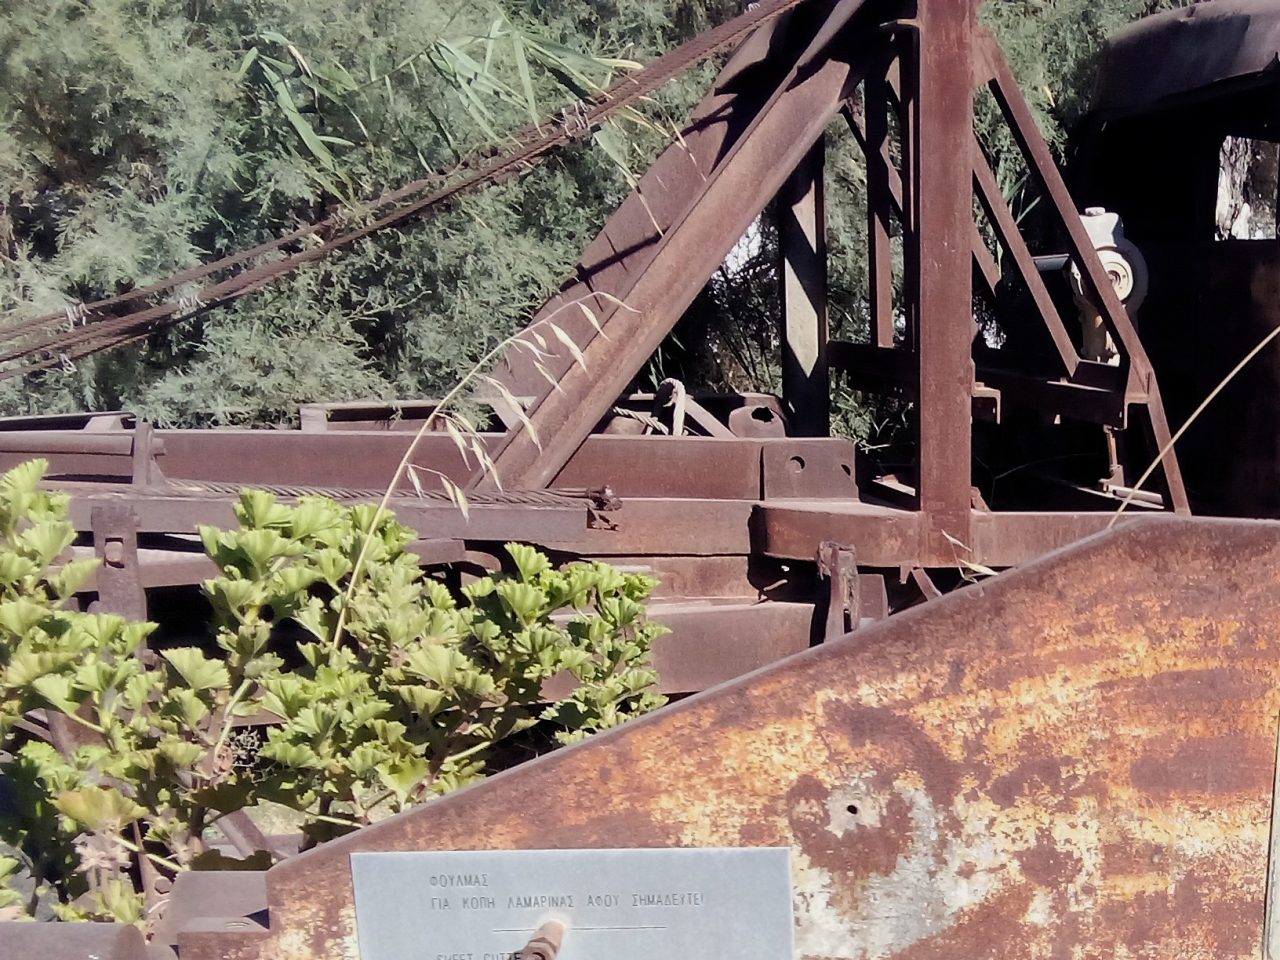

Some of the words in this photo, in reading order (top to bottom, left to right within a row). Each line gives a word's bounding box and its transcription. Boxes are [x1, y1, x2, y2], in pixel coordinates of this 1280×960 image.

[431, 896, 450, 910] ΓΙΑ
[463, 895, 495, 909] ΚΟΠΗ
[507, 894, 575, 909] ΛΑΜΑΡΙΝΑΣ
